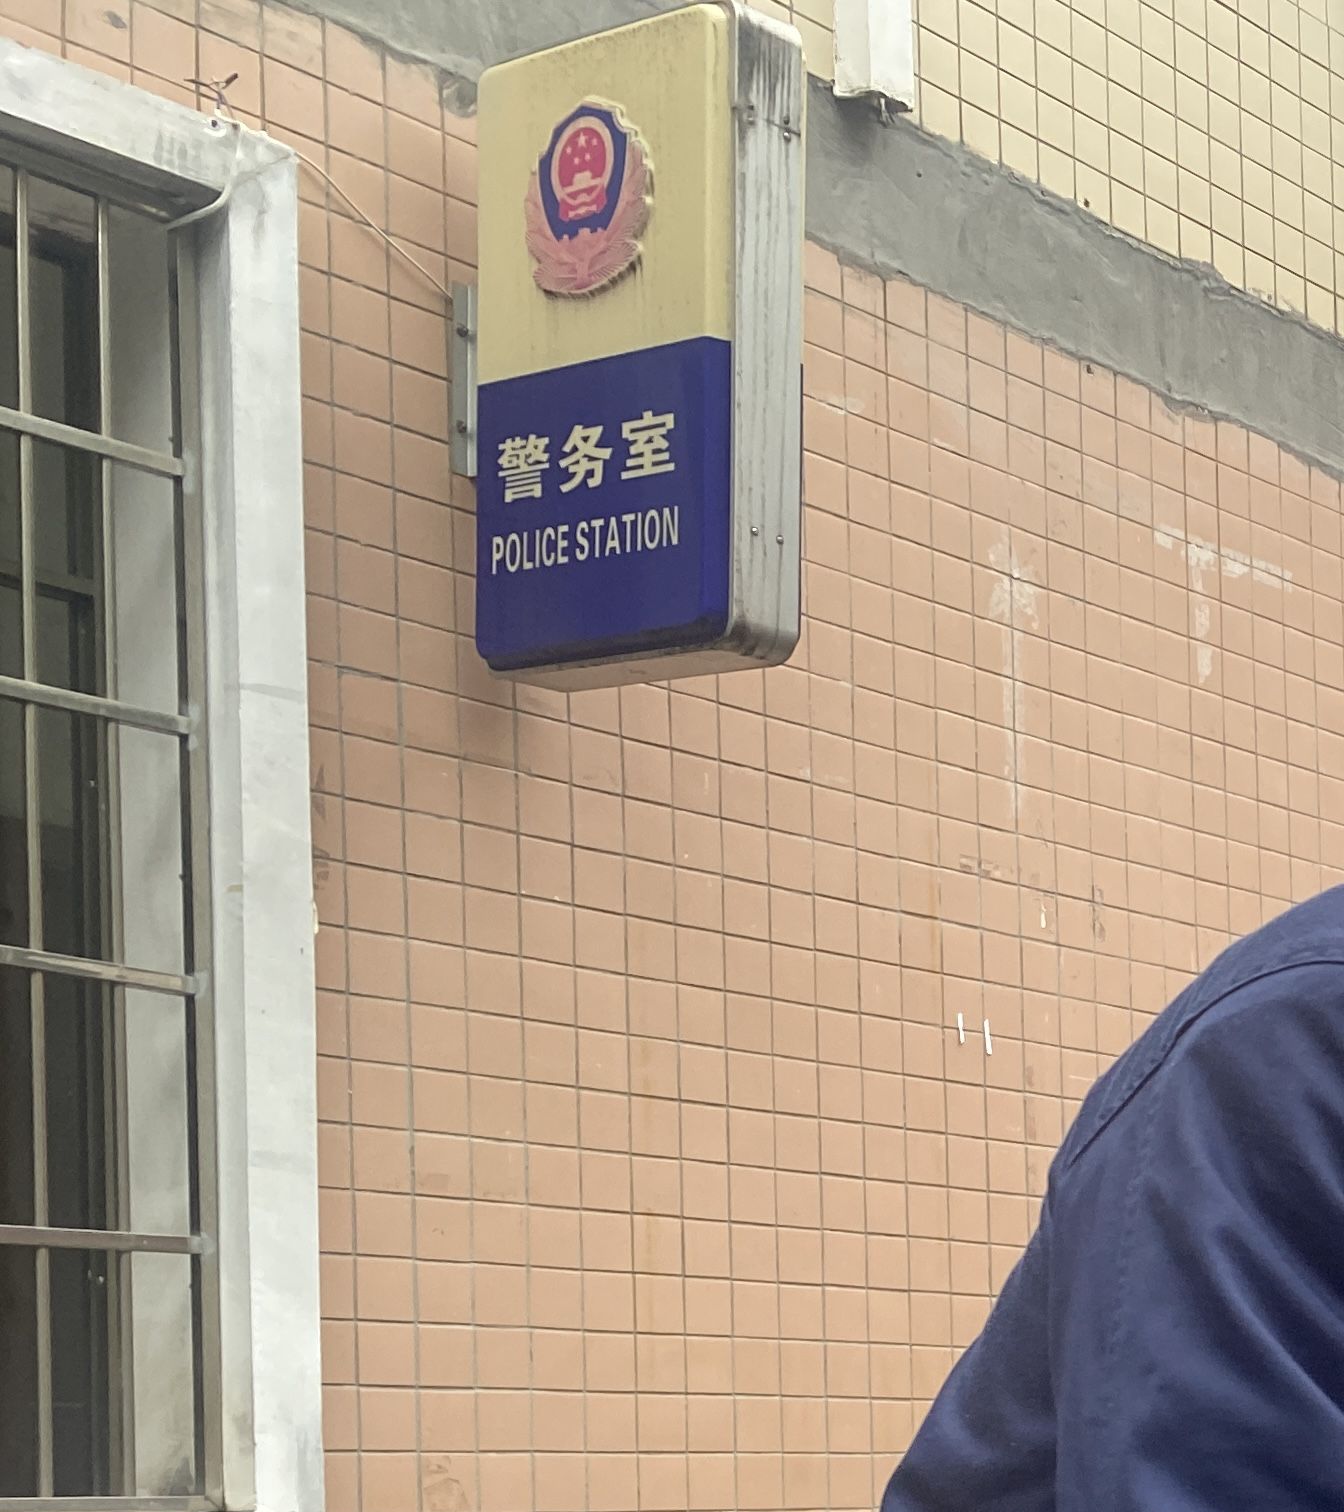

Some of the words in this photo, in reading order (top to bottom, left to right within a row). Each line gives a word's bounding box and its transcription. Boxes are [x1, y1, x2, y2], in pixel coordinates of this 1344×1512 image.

[497, 410, 676, 503] 警务室
[492, 524, 570, 575] POLICE
[575, 505, 679, 561] STATION
